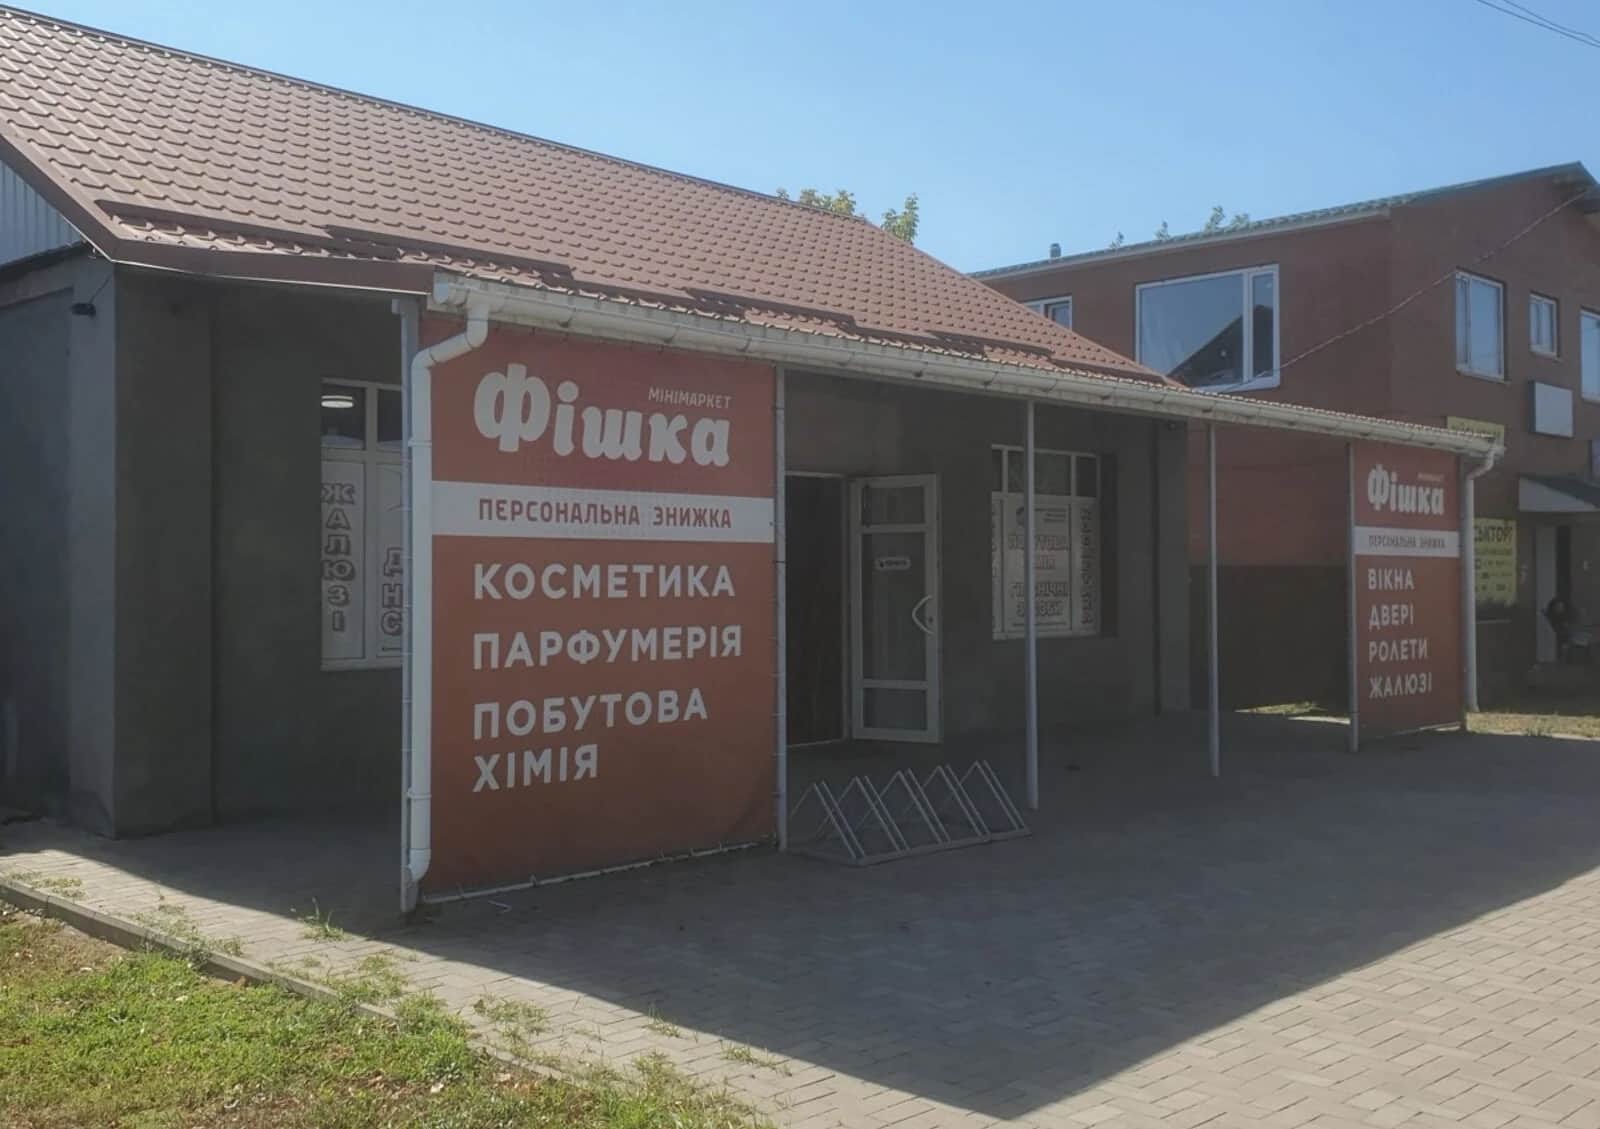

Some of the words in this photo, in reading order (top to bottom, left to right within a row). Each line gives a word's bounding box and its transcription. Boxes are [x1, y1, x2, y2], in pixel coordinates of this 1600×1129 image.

[473, 363, 731, 467] Фішка
[648, 387, 732, 409] МІНІМАРКЕТ
[1367, 463, 1445, 515] Фішка
[479, 498, 640, 526] ПЕРСОНАЛЬНА
[653, 506, 732, 529] ЗНИЖКА
[321, 482, 356, 632] ЖАЛЮЗІ
[473, 563, 736, 600] КОСМЕТИКА
[1367, 567, 1416, 591] ВІКНА
[1368, 602, 1415, 632] ДВЕРІ
[472, 624, 742, 670] ПАРФУМЕРІЯ
[1368, 637, 1429, 664] РОЛЕТИ
[1368, 671, 1433, 700] ЖАЛЮЗІ
[473, 688, 709, 740] ПОБУТОВА
[472, 744, 599, 793] ХІМІЯ
